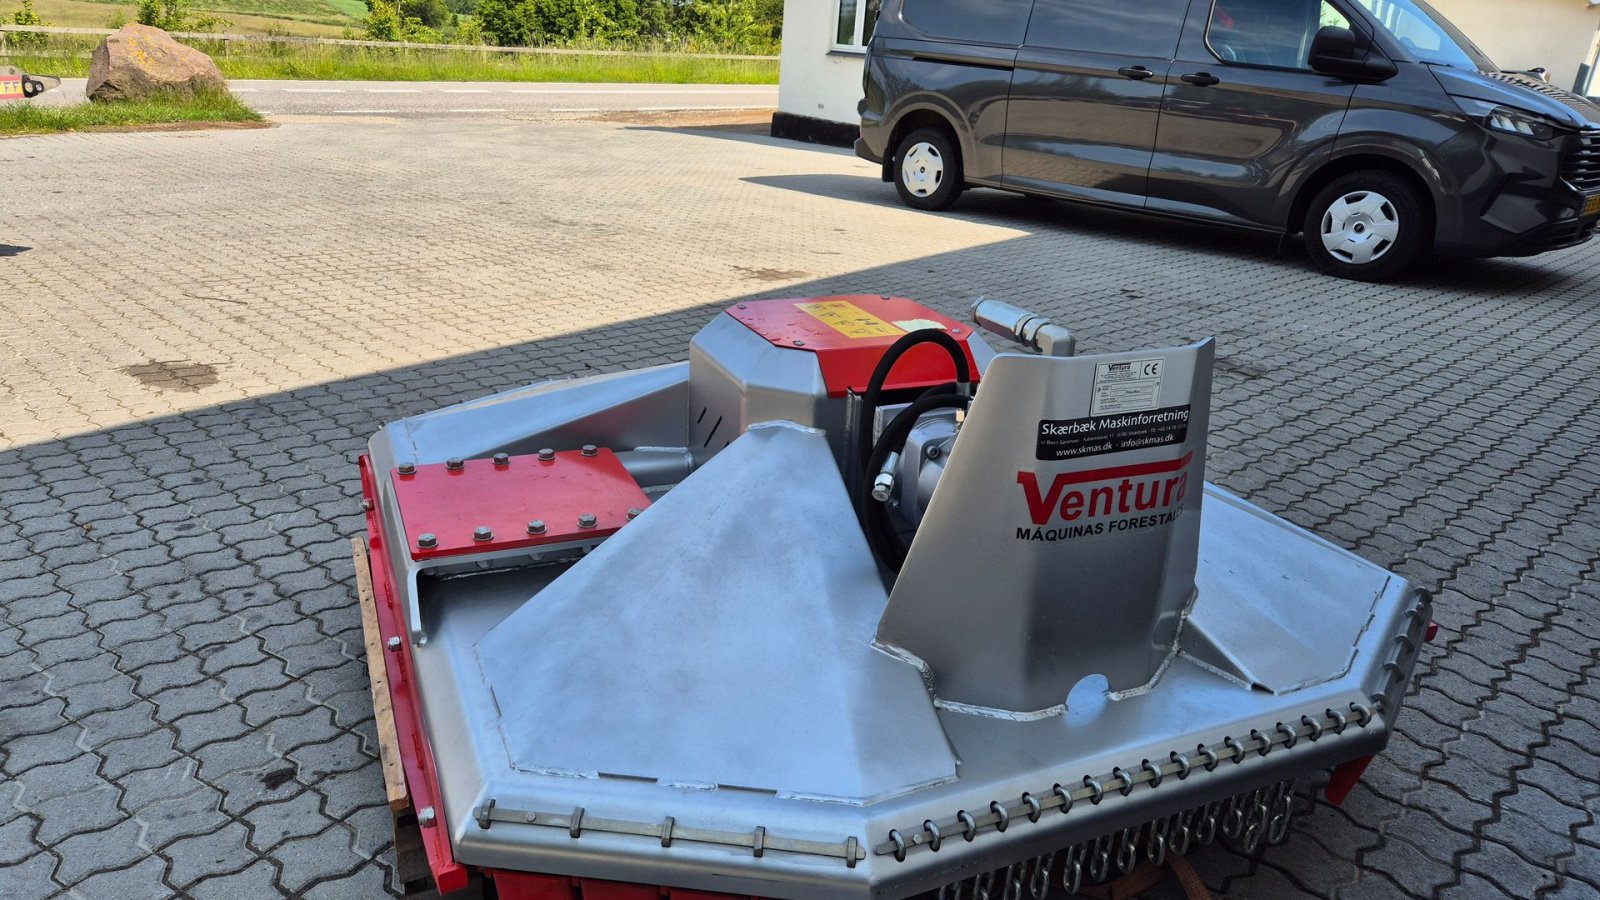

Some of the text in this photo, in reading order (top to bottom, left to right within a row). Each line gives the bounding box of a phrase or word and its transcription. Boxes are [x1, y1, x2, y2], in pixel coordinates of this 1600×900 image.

[1108, 362, 1131, 371] Ventura
[1041, 410, 1189, 435] Skærbæk Maskinforretning
[1055, 442, 1113, 457] www.skmas.dk
[1121, 434, 1174, 447] info@skmas.dk
[1017, 451, 1192, 526] Ventura
[1016, 504, 1184, 542] MÁQUINAS FORESTALES
